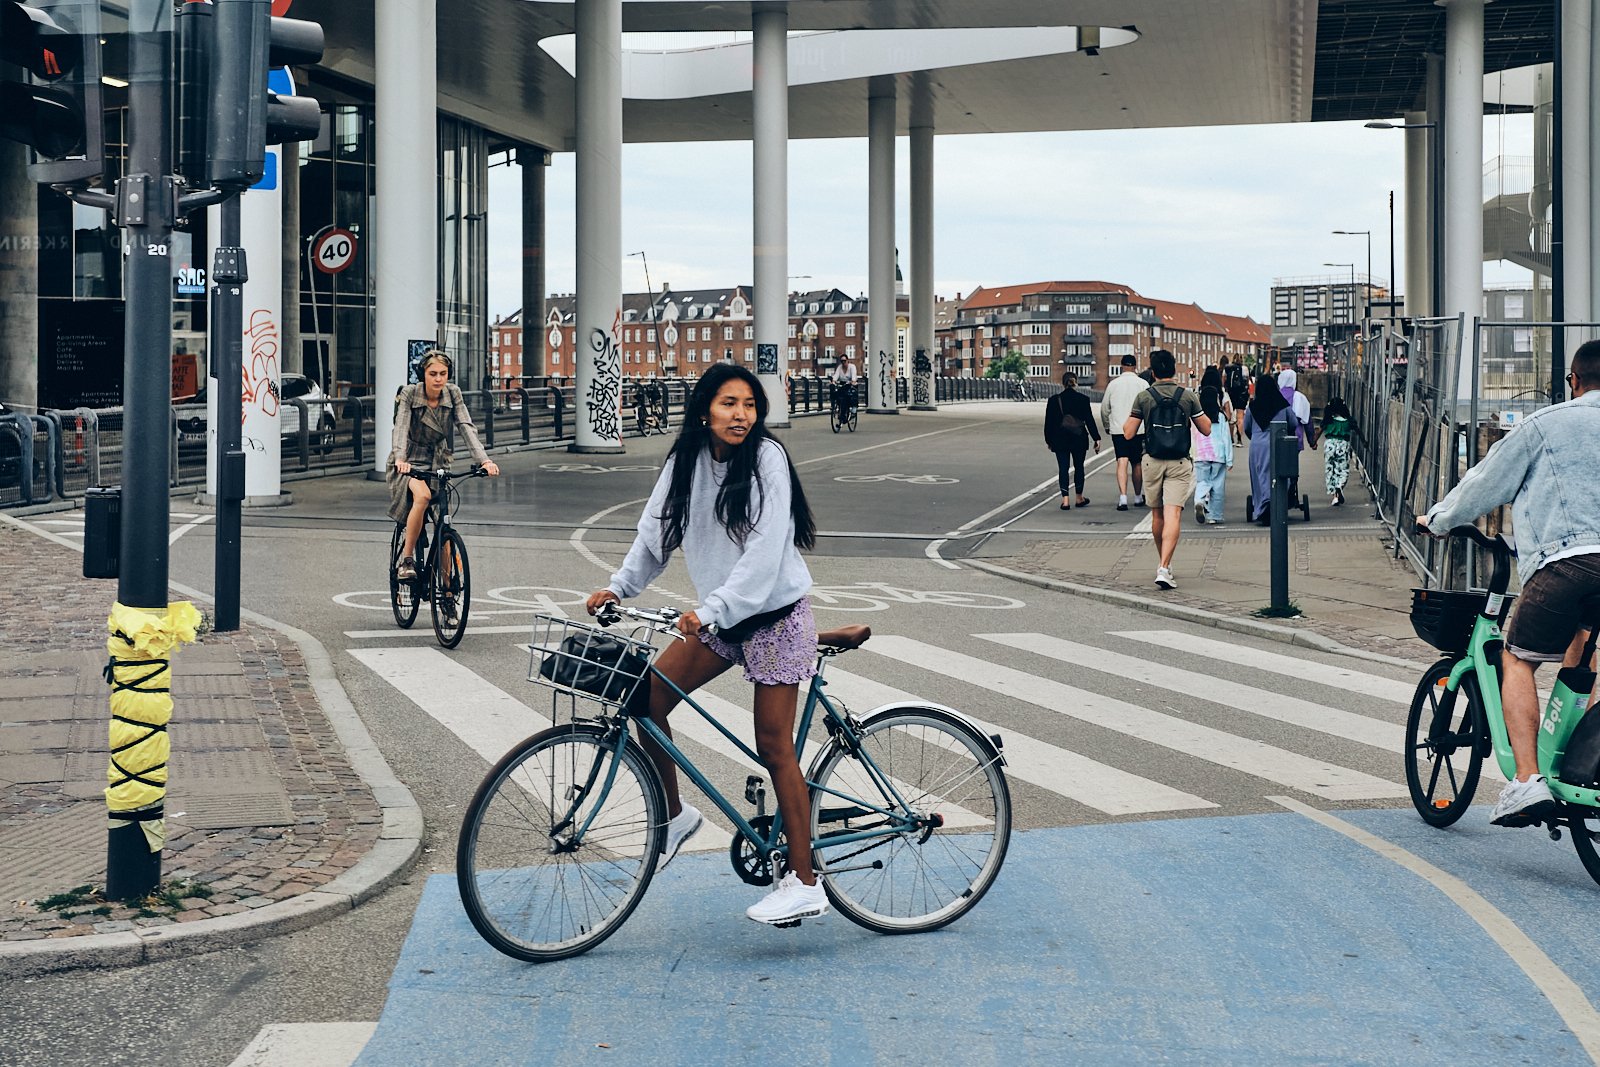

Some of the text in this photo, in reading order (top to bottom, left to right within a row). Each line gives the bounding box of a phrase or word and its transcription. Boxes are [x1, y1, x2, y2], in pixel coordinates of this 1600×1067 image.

[147, 244, 167, 256] 20
[322, 240, 350, 260] 40
[230, 287, 240, 296] 19
[1543, 696, 1563, 736] Bolt
